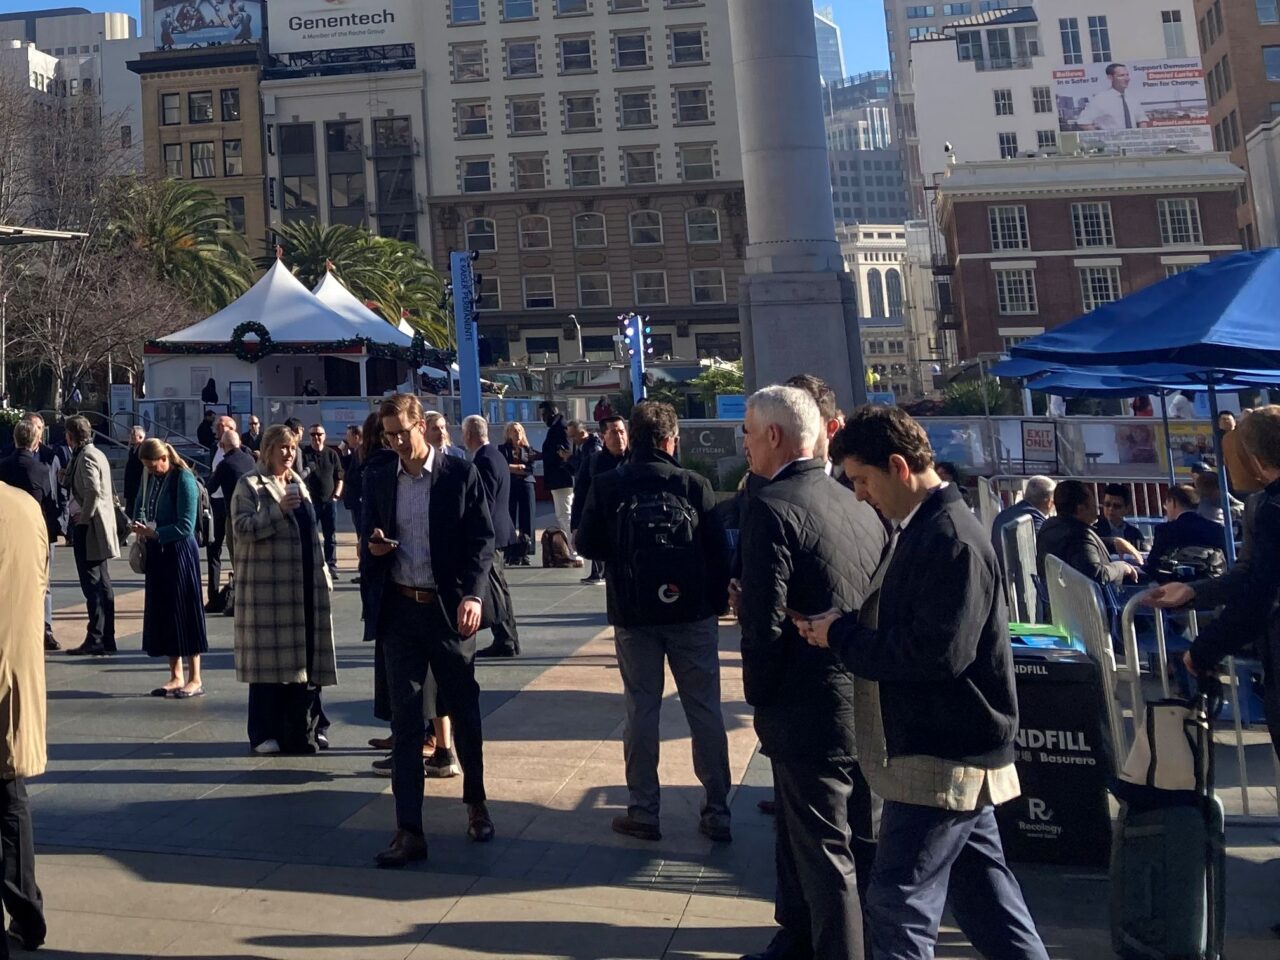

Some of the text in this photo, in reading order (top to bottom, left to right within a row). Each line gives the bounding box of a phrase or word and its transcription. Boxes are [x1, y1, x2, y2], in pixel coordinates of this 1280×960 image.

[288, 8, 395, 31] Genentech
[307, 32, 330, 40] Member
[367, 28, 385, 36] Group
[1133, 62, 1199, 71] Support Democrat
[1149, 72, 1174, 80] Daniel
[1026, 429, 1051, 438] EXIT
[1025, 438, 1054, 448] ONLY
[1014, 664, 1049, 675] NDFILL
[1016, 728, 1091, 752] NDFILL
[1040, 752, 1097, 766] Basurero
[1018, 821, 1062, 835] Recology
